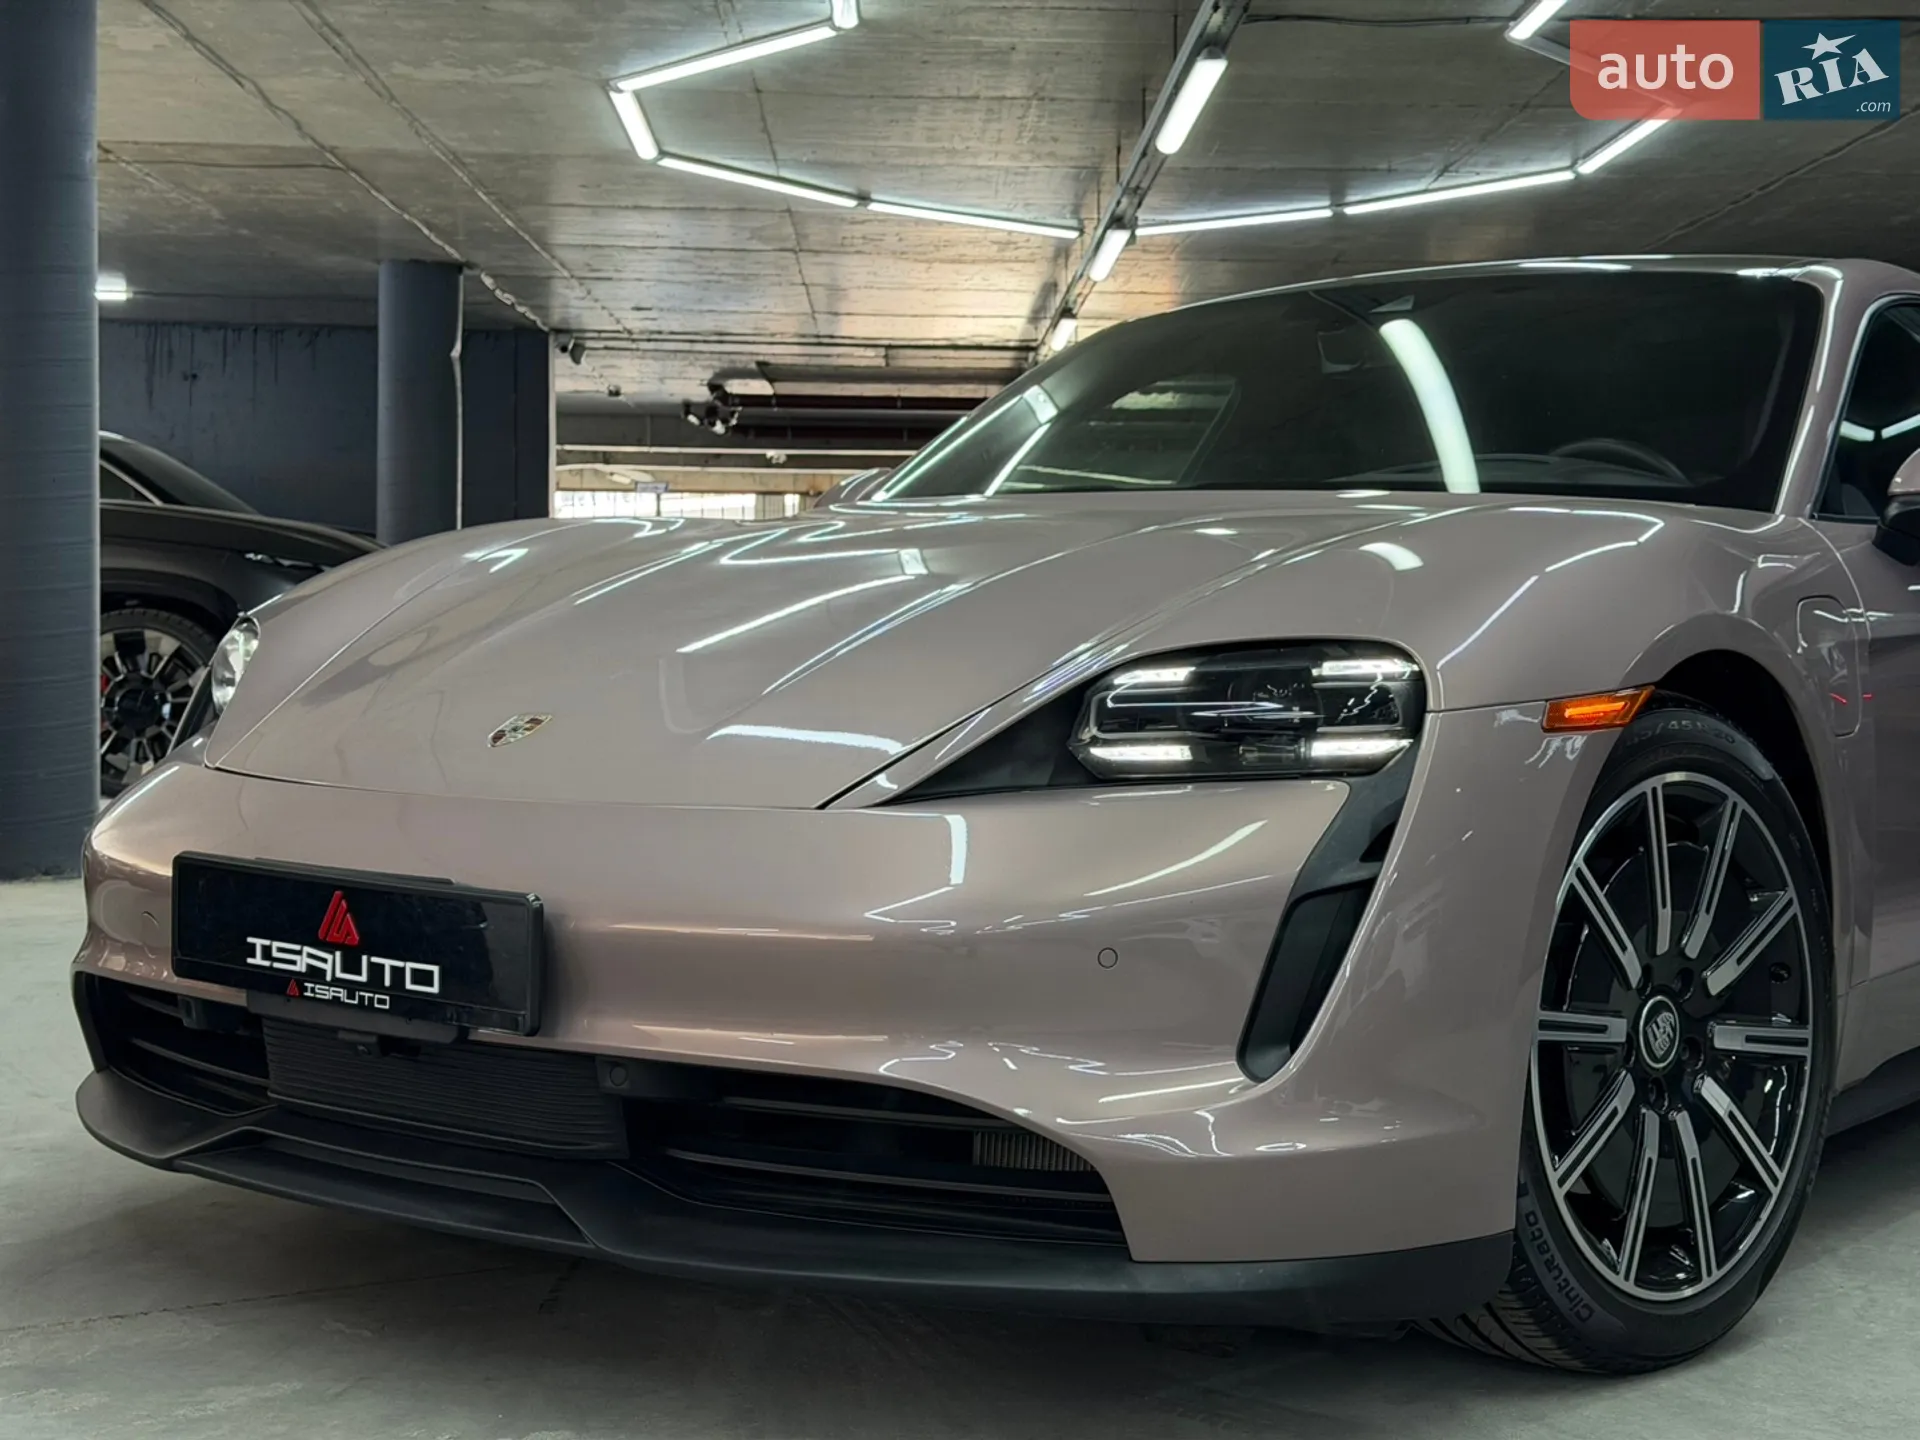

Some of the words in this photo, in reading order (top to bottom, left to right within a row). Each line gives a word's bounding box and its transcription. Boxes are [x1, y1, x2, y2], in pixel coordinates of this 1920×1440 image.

[246, 936, 440, 994] ISAUTO
[303, 982, 390, 1010] ISAUTO
[1524, 1209, 1597, 1324] Cinturato
